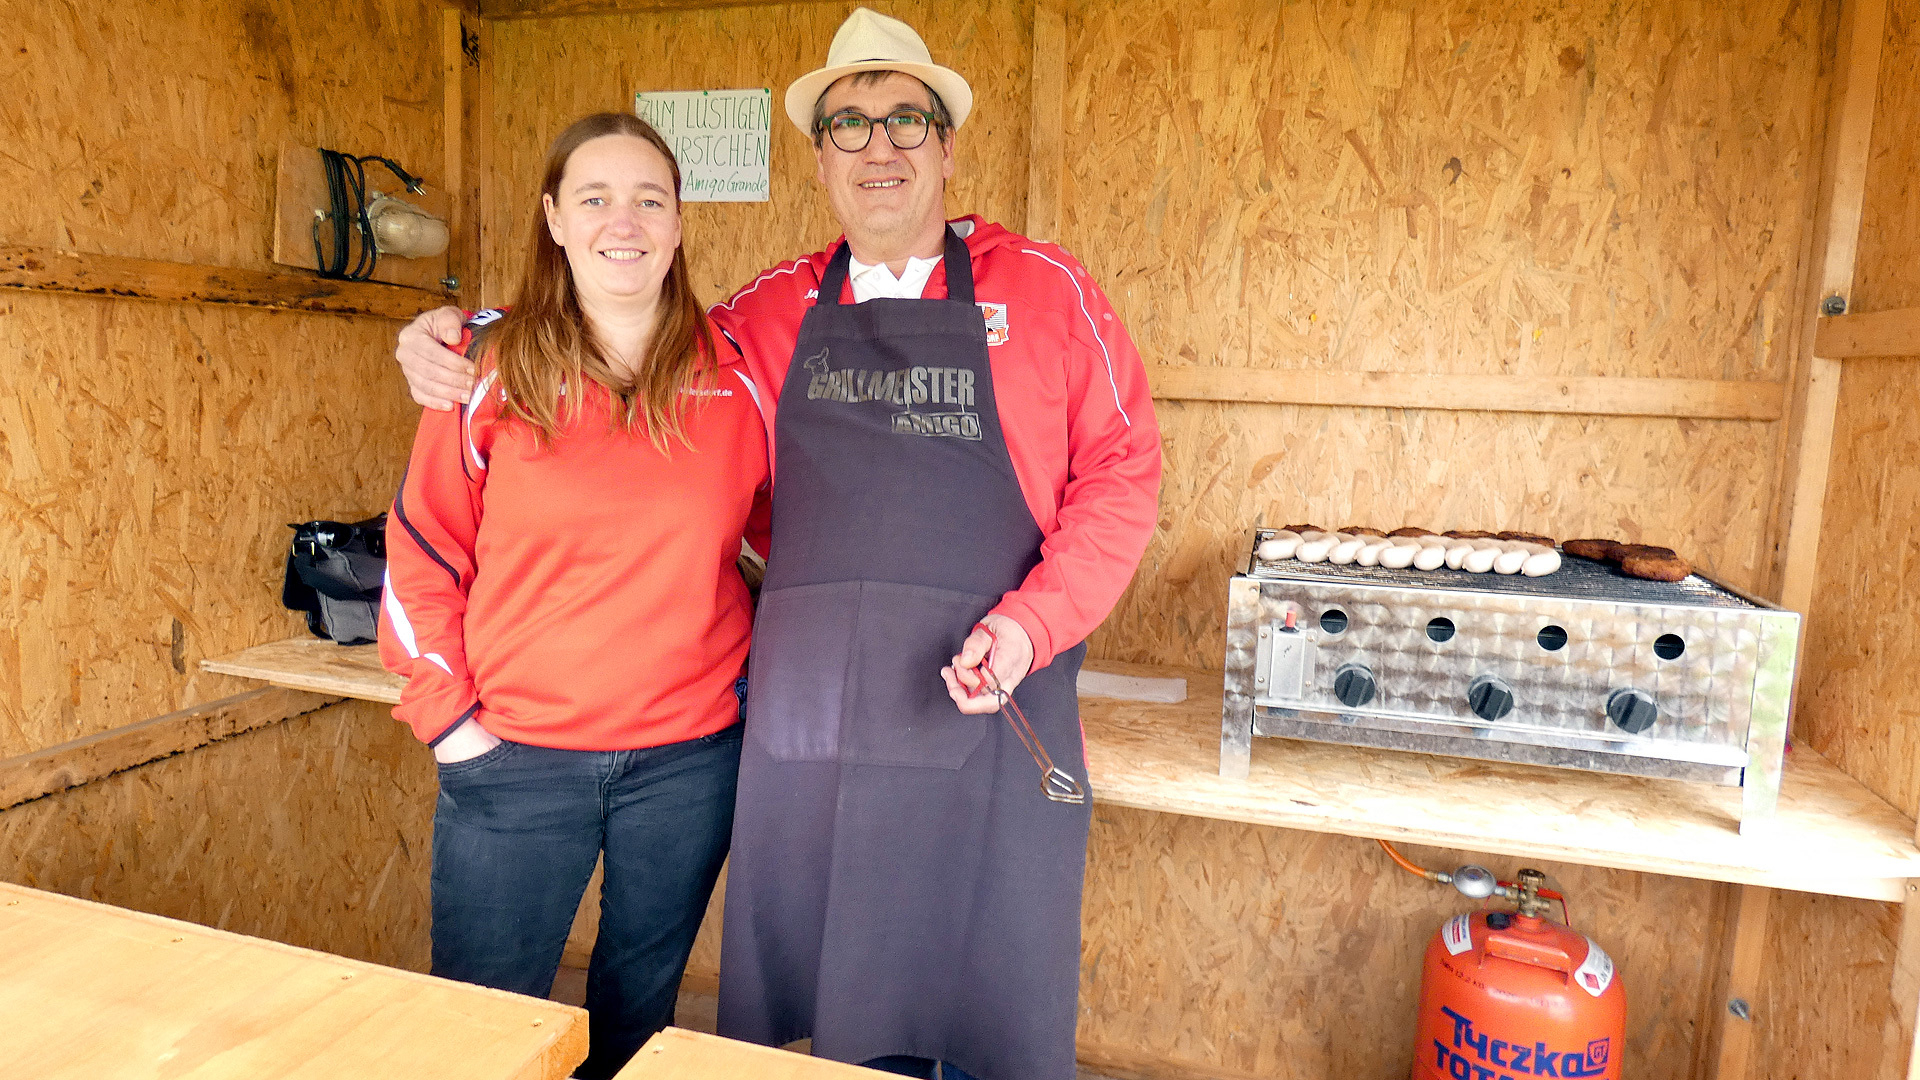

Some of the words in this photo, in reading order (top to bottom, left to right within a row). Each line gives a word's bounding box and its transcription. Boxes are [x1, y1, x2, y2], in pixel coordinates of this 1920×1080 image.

[637, 99, 675, 135] ZUM
[686, 96, 770, 131] LUSTIGEN
[664, 133, 767, 167] RSTCHEN
[685, 170, 725, 198] Amigo
[726, 171, 768, 193] Grande
[803, 288, 819, 300] JA
[807, 366, 975, 406] GRILLMEISTER
[895, 413, 979, 438] AMIGO
[1440, 1005, 1607, 1079] Tyczka
